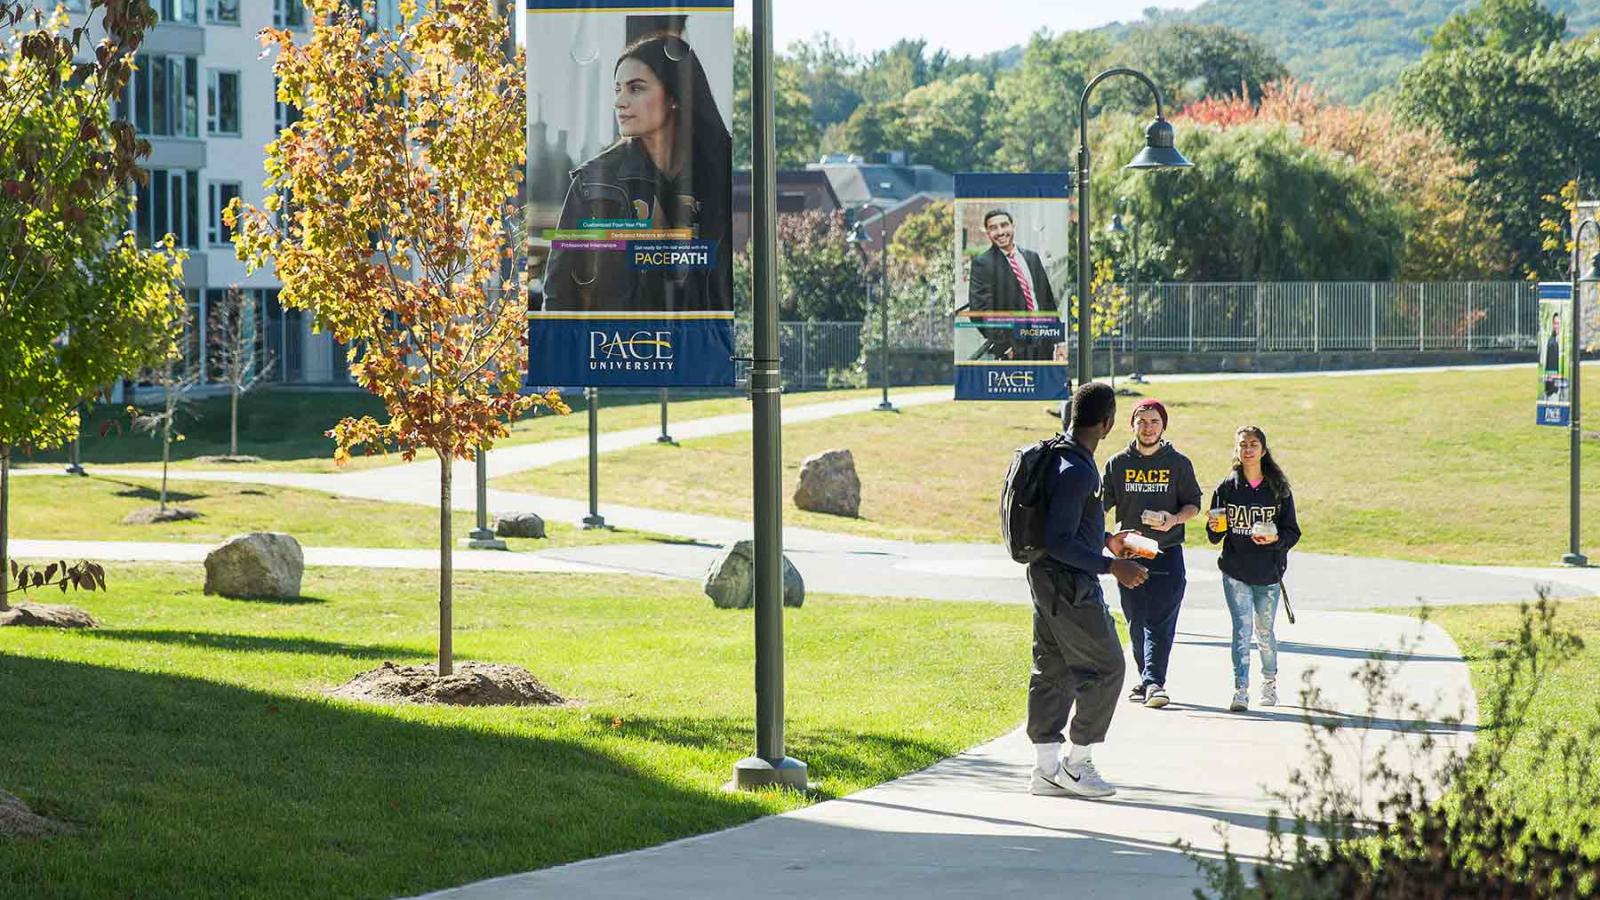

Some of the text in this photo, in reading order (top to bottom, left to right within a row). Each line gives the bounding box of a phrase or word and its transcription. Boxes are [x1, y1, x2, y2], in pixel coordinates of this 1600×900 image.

[634, 252, 708, 265] PACEPATH
[1020, 328, 1060, 337] PACEPATH
[590, 331, 673, 359] PACE
[988, 371, 1034, 387] PACE
[1125, 469, 1170, 482] PACE
[1125, 483, 1169, 492] UNIVERSITY
[1227, 503, 1276, 529] PACE
